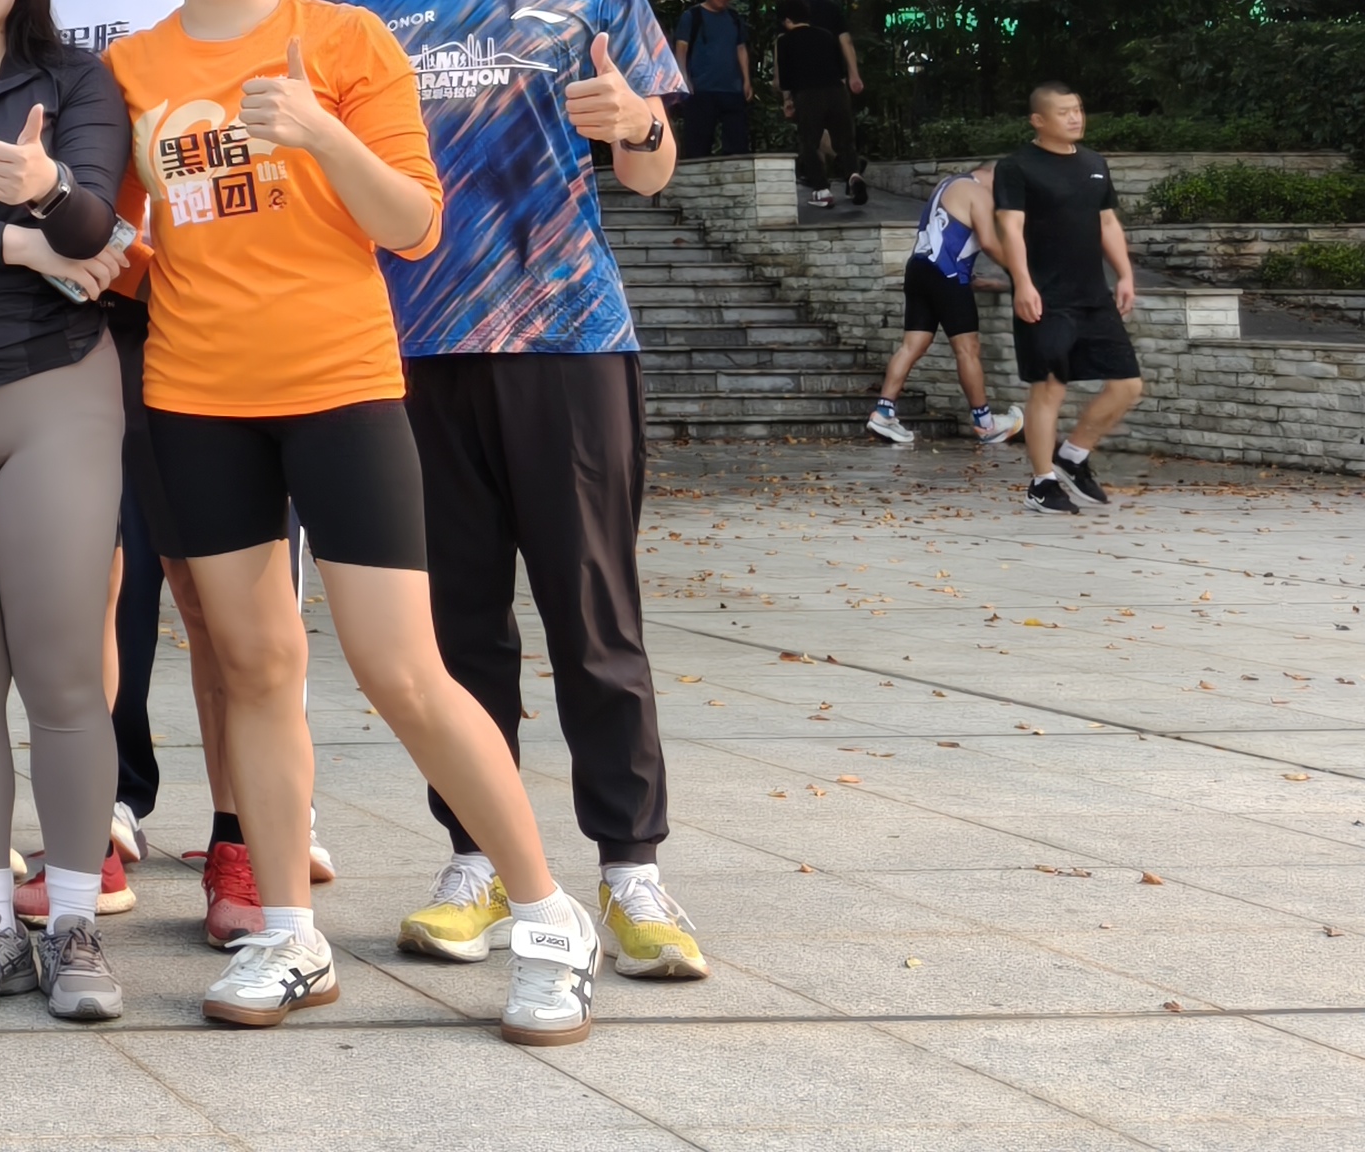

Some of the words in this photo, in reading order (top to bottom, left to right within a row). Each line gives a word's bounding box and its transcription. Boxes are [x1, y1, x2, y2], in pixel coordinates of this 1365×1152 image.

[387, 10, 436, 32] ONOR
[415, 68, 510, 90] RATHON
[417, 86, 477, 101] 深圳马拉松
[159, 125, 251, 180] 黑暗
[167, 171, 259, 227] 跑团
